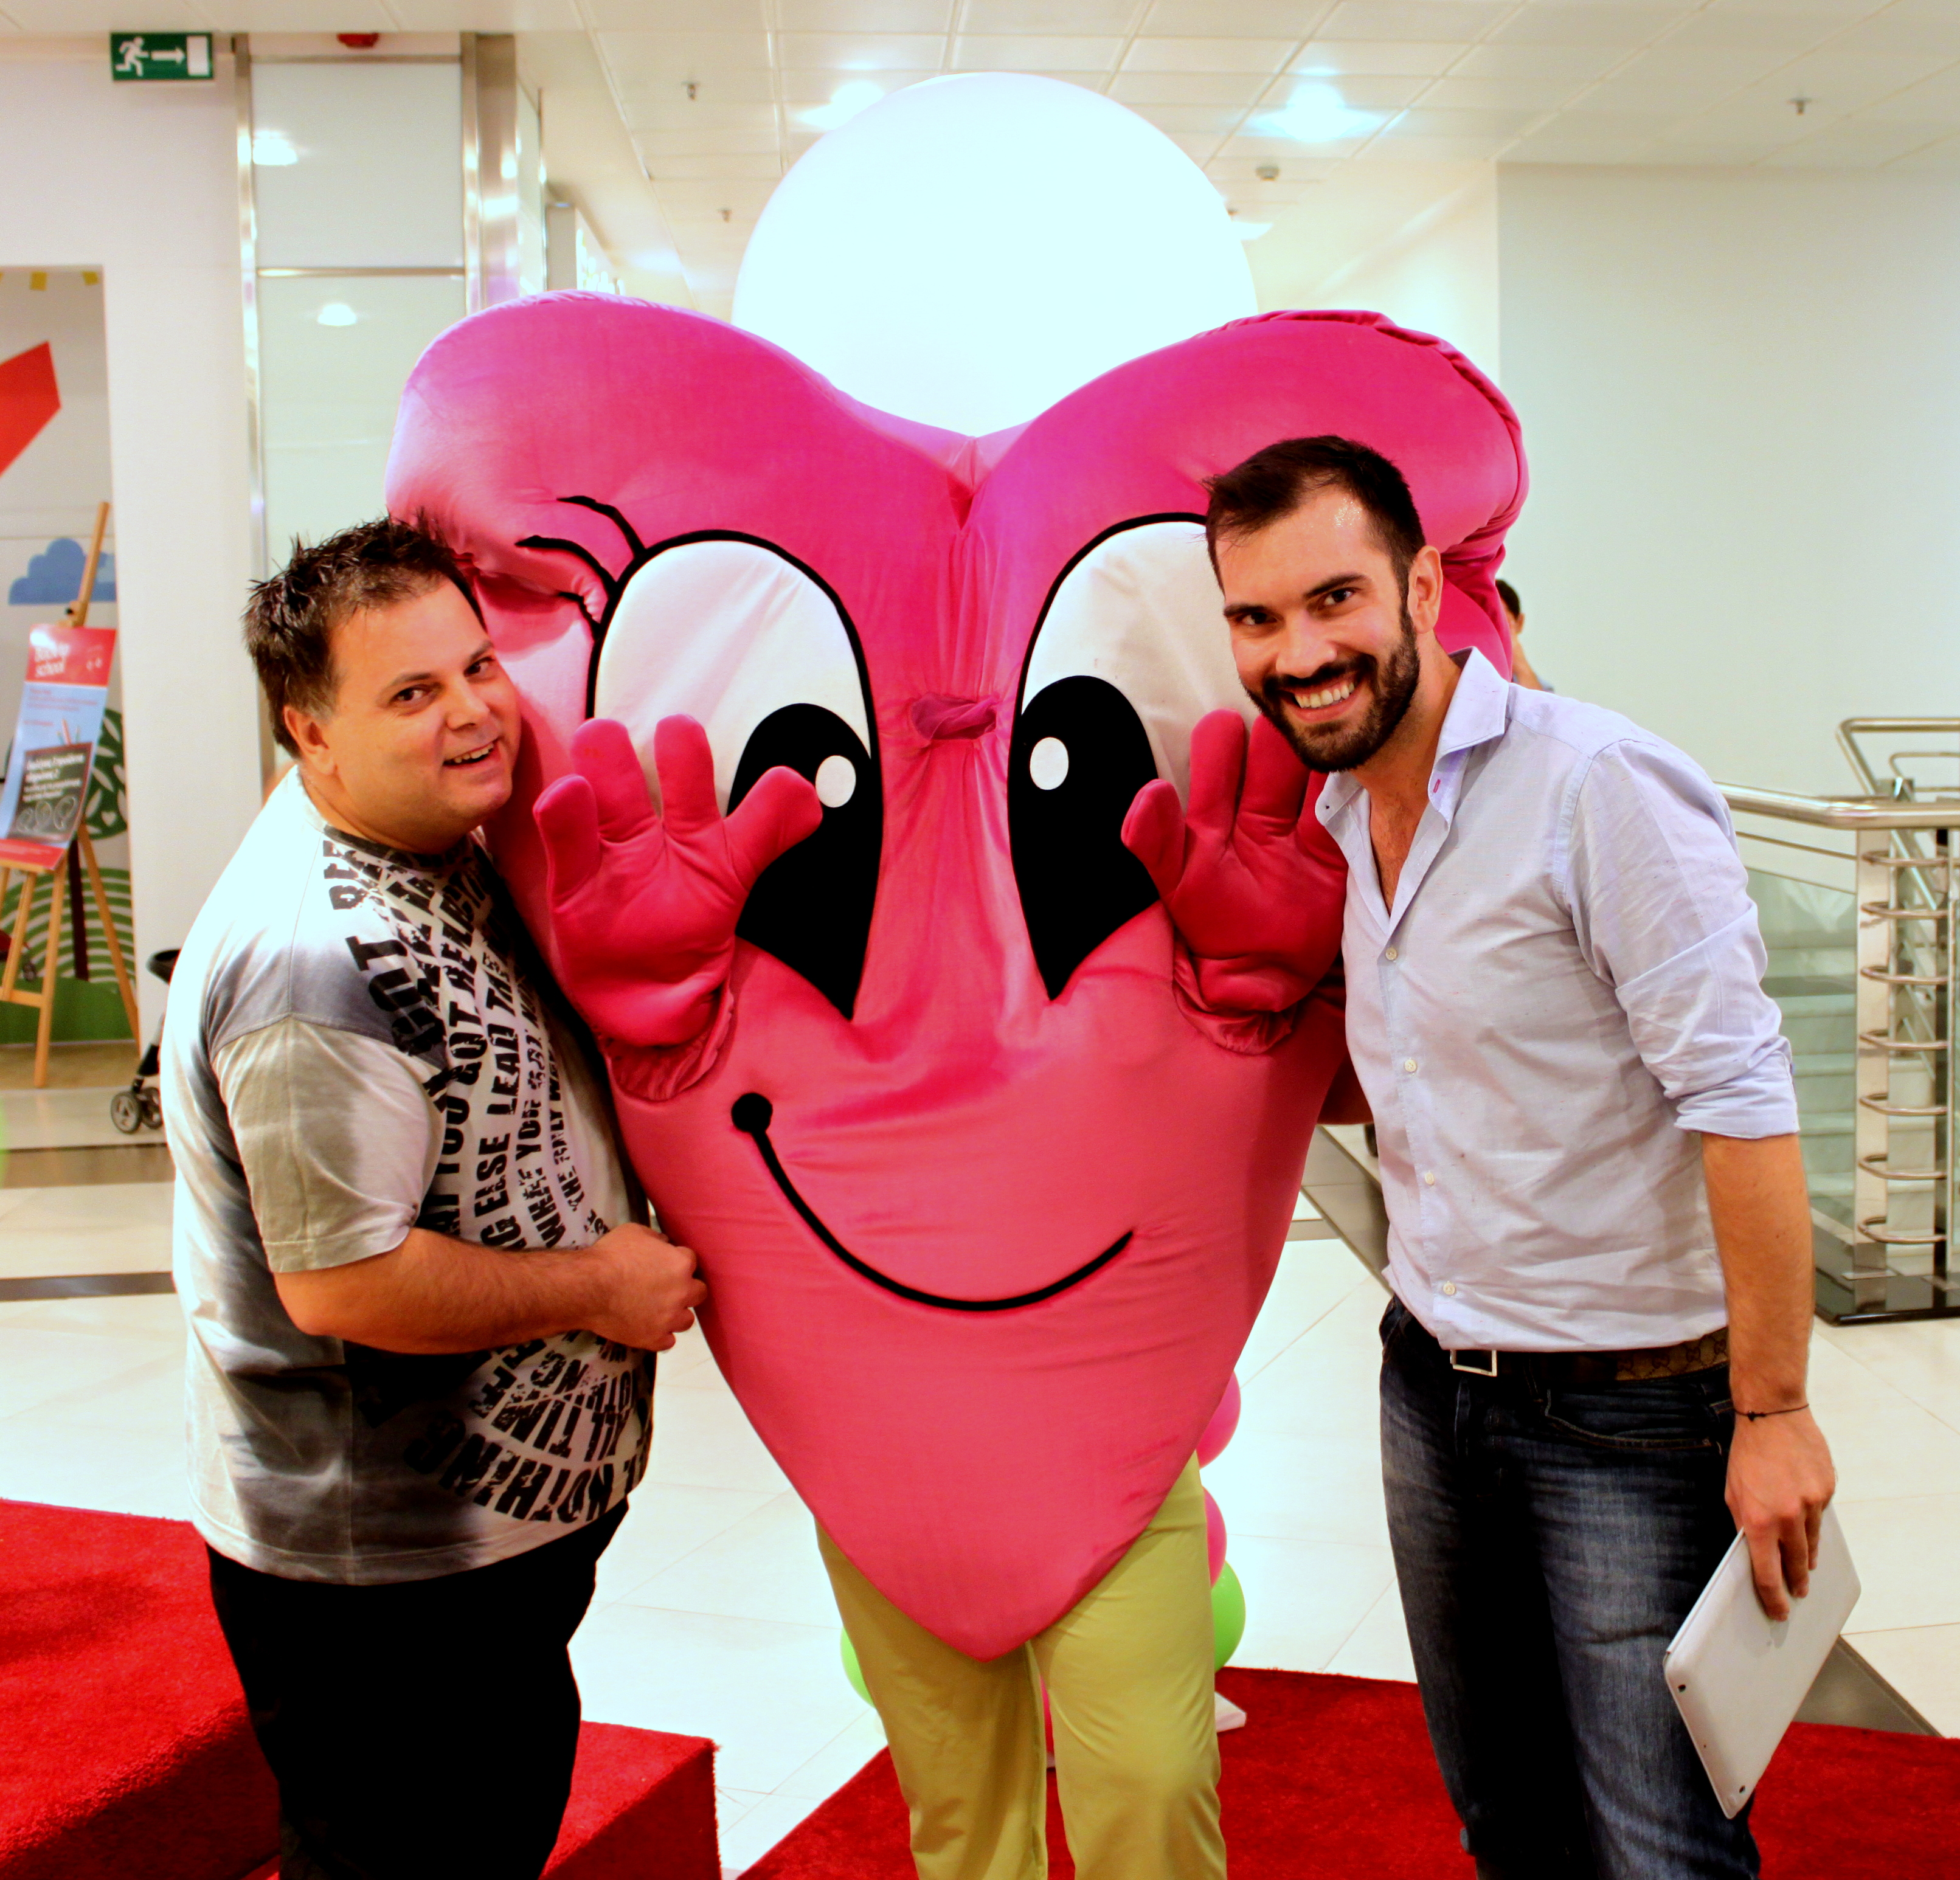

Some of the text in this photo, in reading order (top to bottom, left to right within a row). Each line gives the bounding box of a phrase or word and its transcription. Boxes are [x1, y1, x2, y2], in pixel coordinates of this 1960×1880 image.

[486, 1023, 521, 1115] LEAD
[474, 1132, 511, 1217] ELSE
[404, 1414, 614, 1524] NOTHING
